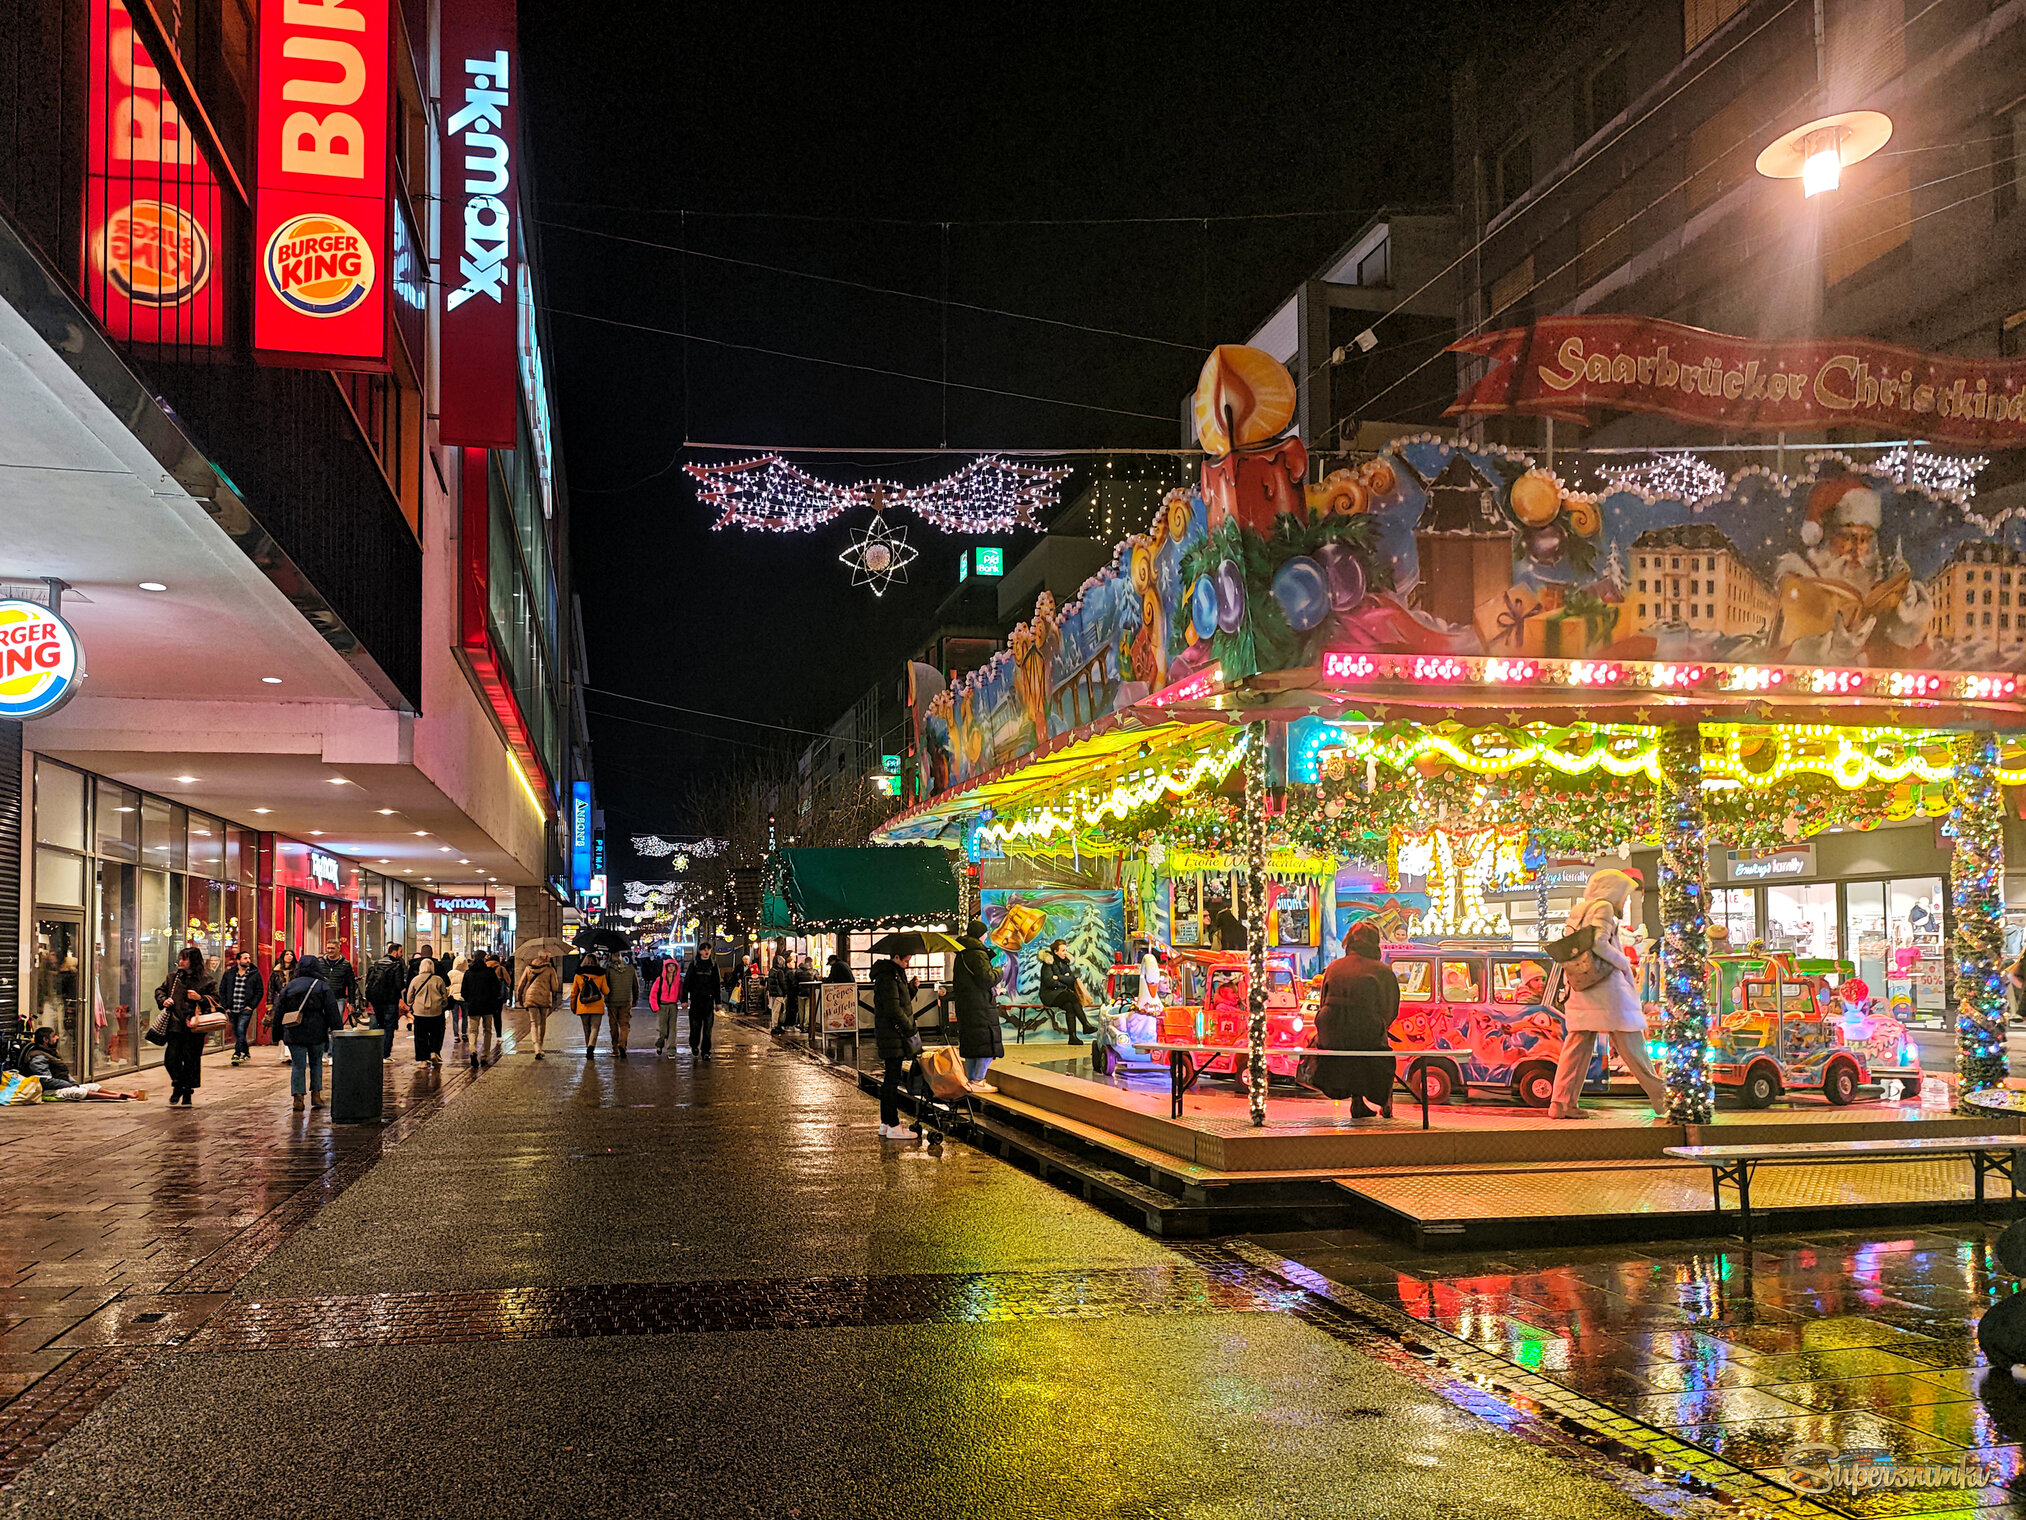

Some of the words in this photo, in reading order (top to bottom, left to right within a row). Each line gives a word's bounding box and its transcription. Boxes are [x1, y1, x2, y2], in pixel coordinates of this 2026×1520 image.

[278, 235, 359, 265] BURGER
[281, 252, 362, 291] KING
[1538, 336, 1808, 402] Saarbrücker
[595, 839, 604, 870] PRIMA
[1772, 857, 1804, 874] family
[825, 987, 854, 1002] Crêpes
